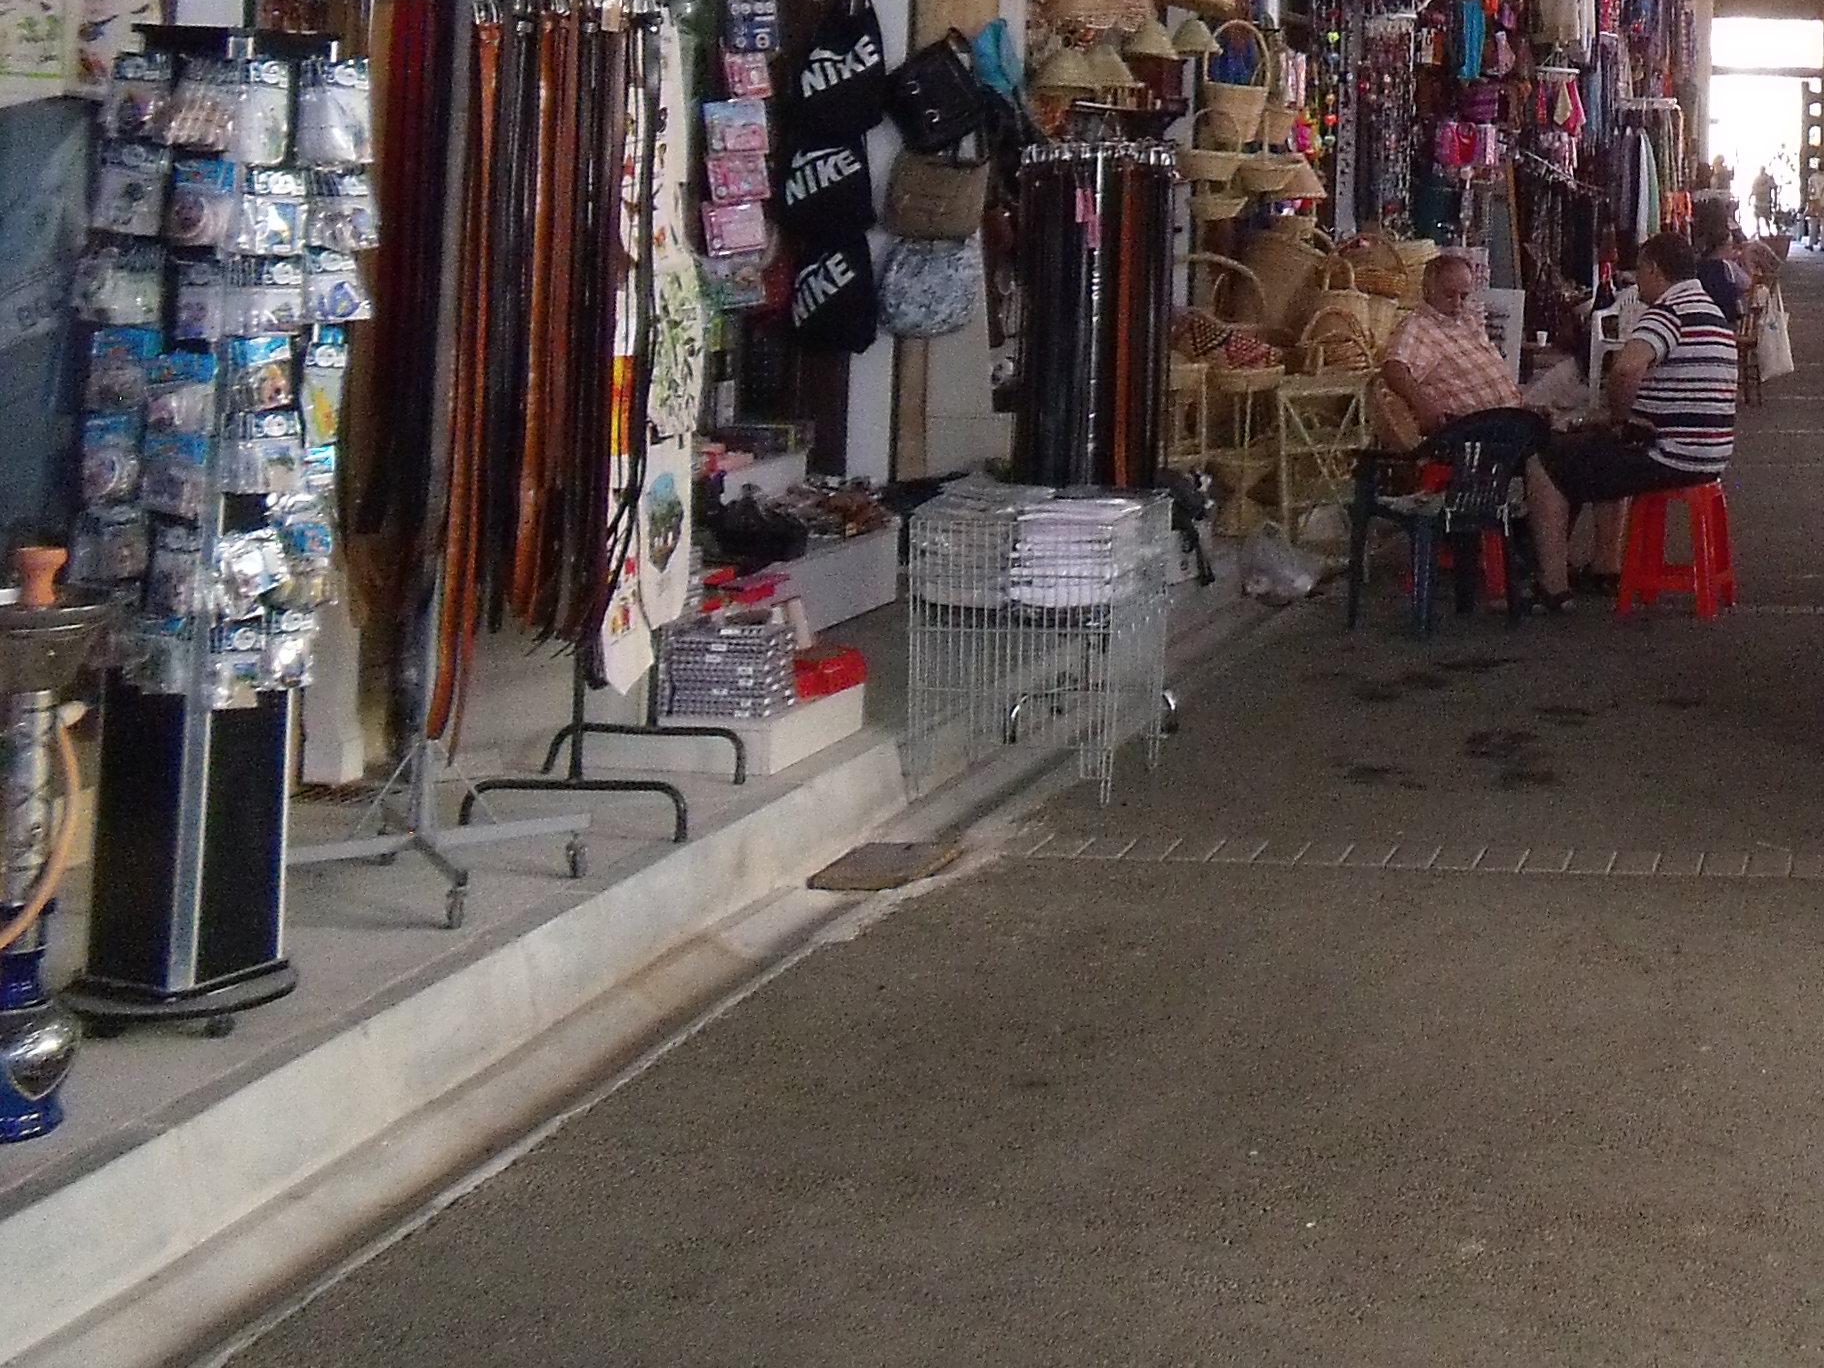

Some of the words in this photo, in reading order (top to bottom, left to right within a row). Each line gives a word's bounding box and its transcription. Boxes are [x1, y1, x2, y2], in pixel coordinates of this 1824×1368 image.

[800, 34, 881, 99] NIKE
[785, 148, 862, 206] NIKE
[791, 252, 857, 329] NIKE
